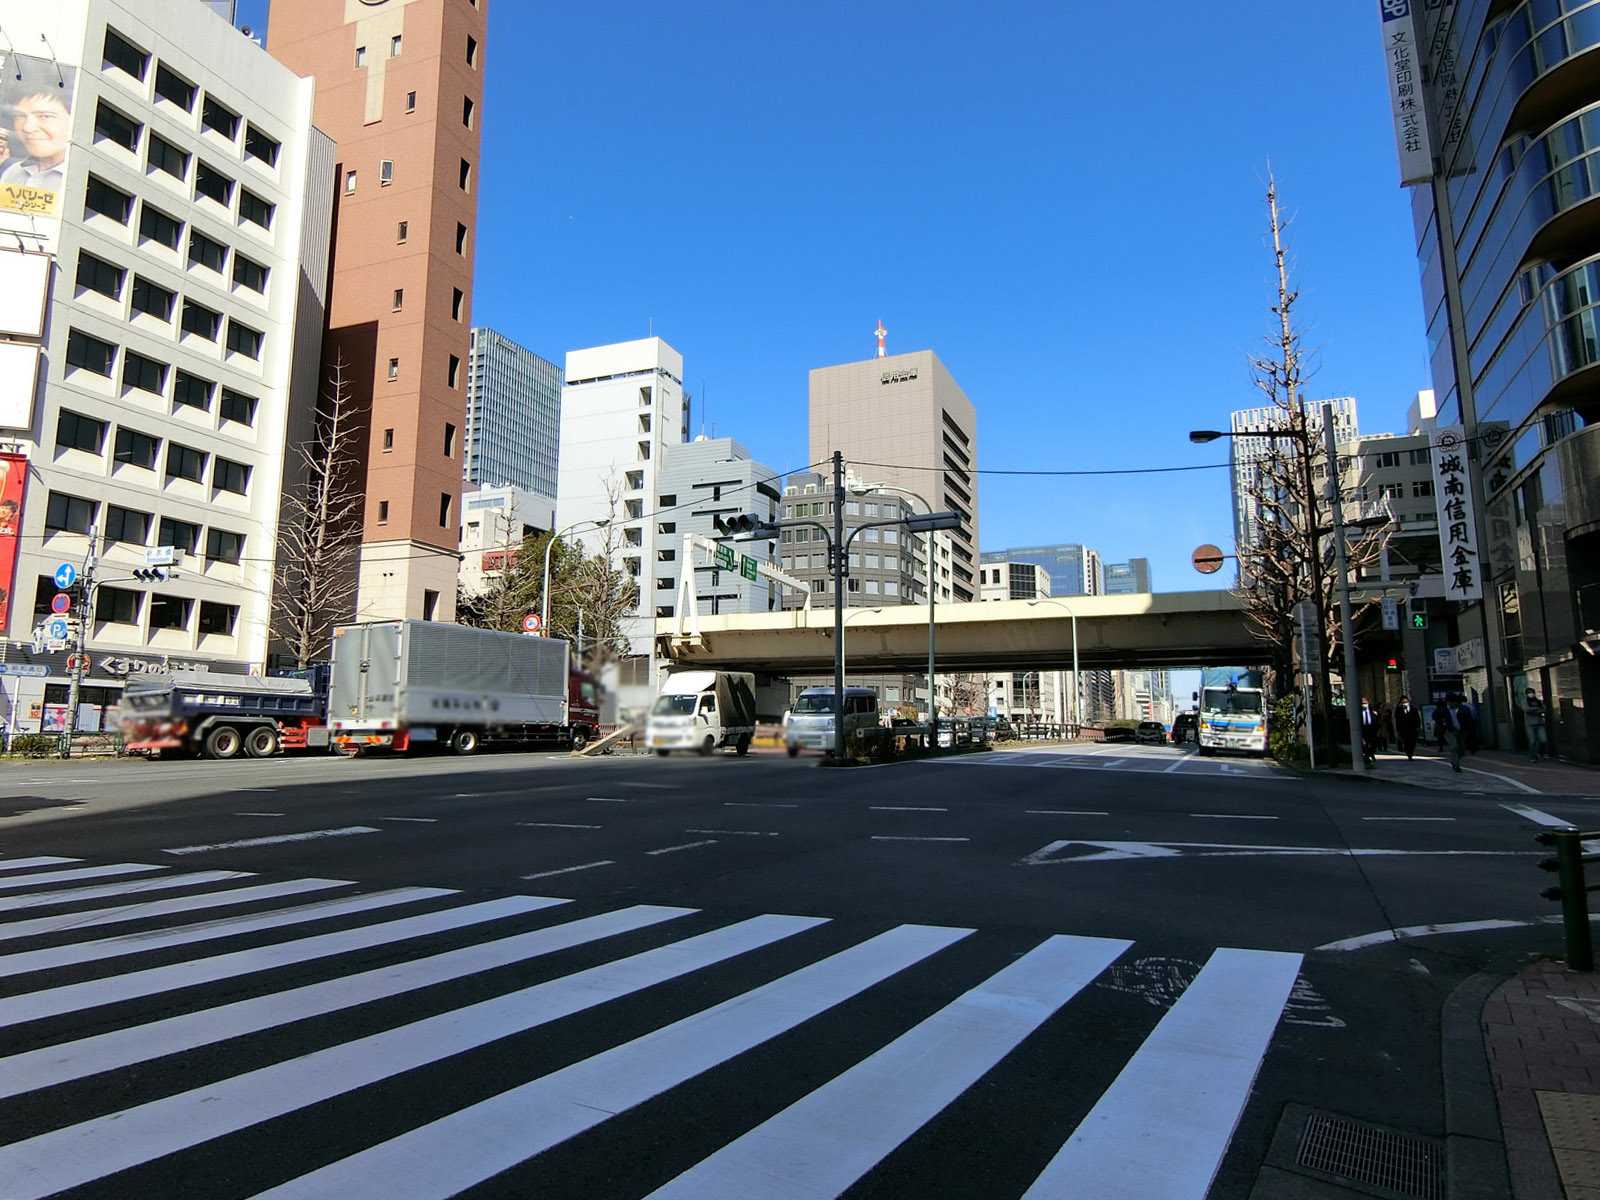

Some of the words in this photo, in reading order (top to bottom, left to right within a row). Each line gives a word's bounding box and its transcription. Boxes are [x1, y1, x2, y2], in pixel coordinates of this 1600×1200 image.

[1391, 31, 1422, 153] 文化堂印刷株式会社
[1438, 454, 1476, 595] 城南信用金庫
